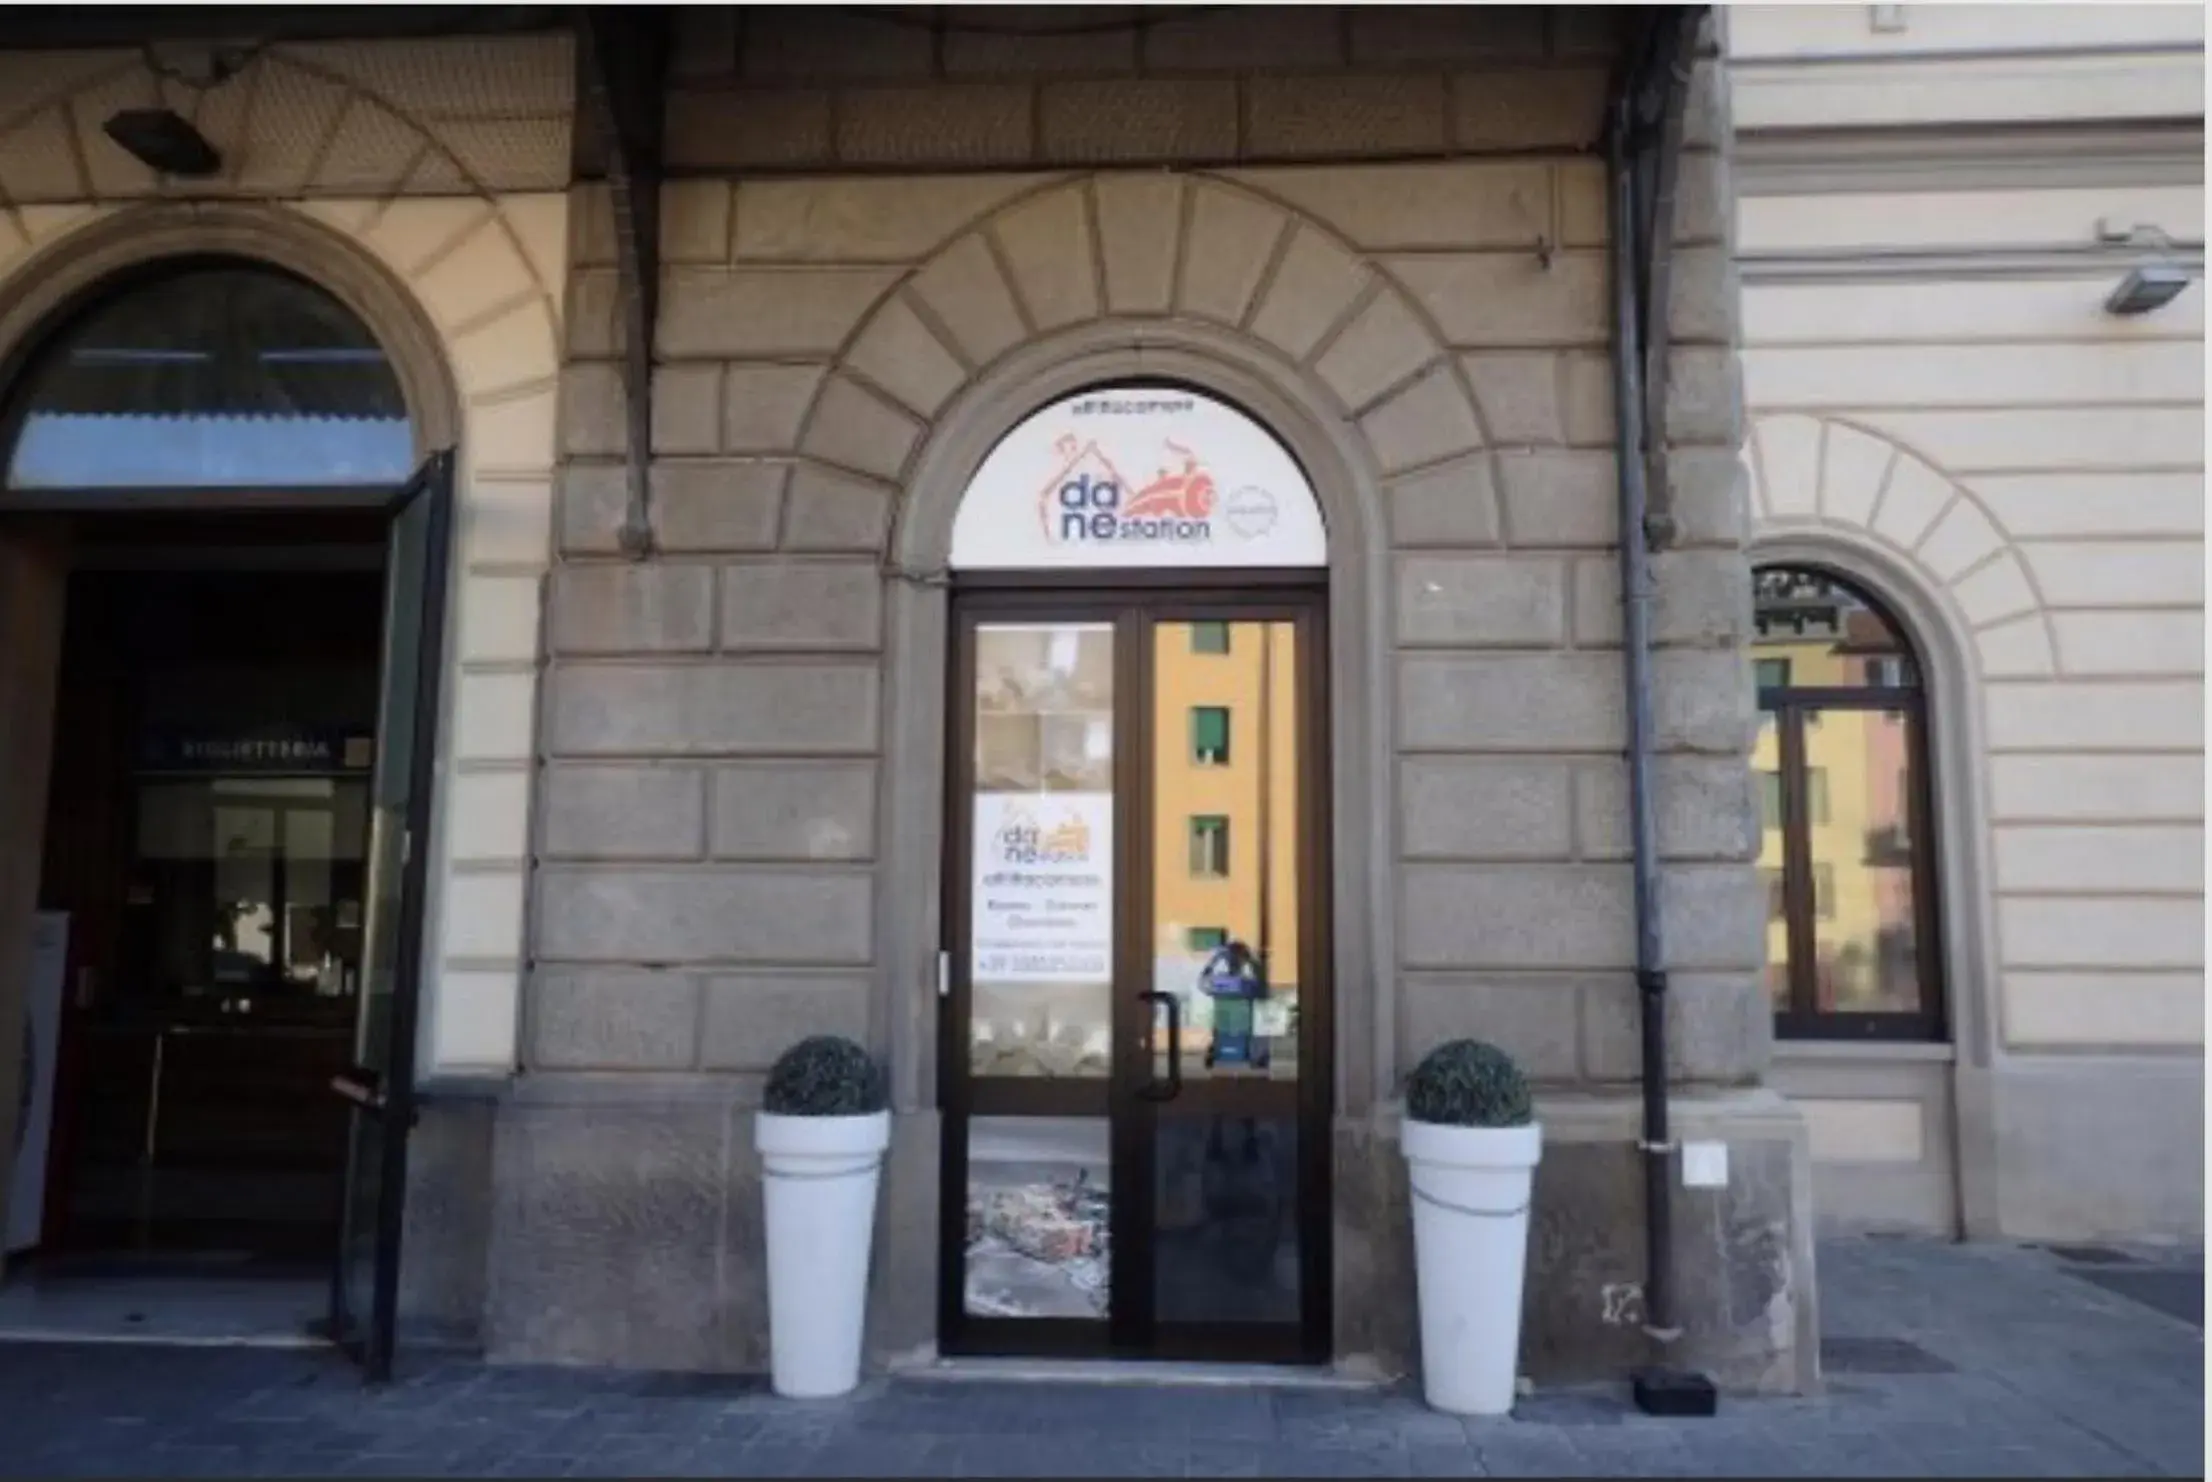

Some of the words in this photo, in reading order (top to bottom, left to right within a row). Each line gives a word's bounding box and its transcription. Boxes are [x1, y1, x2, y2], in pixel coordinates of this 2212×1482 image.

[1059, 473, 1119, 509] da
[1061, 512, 1118, 540] ne
[1119, 517, 1211, 540] station
